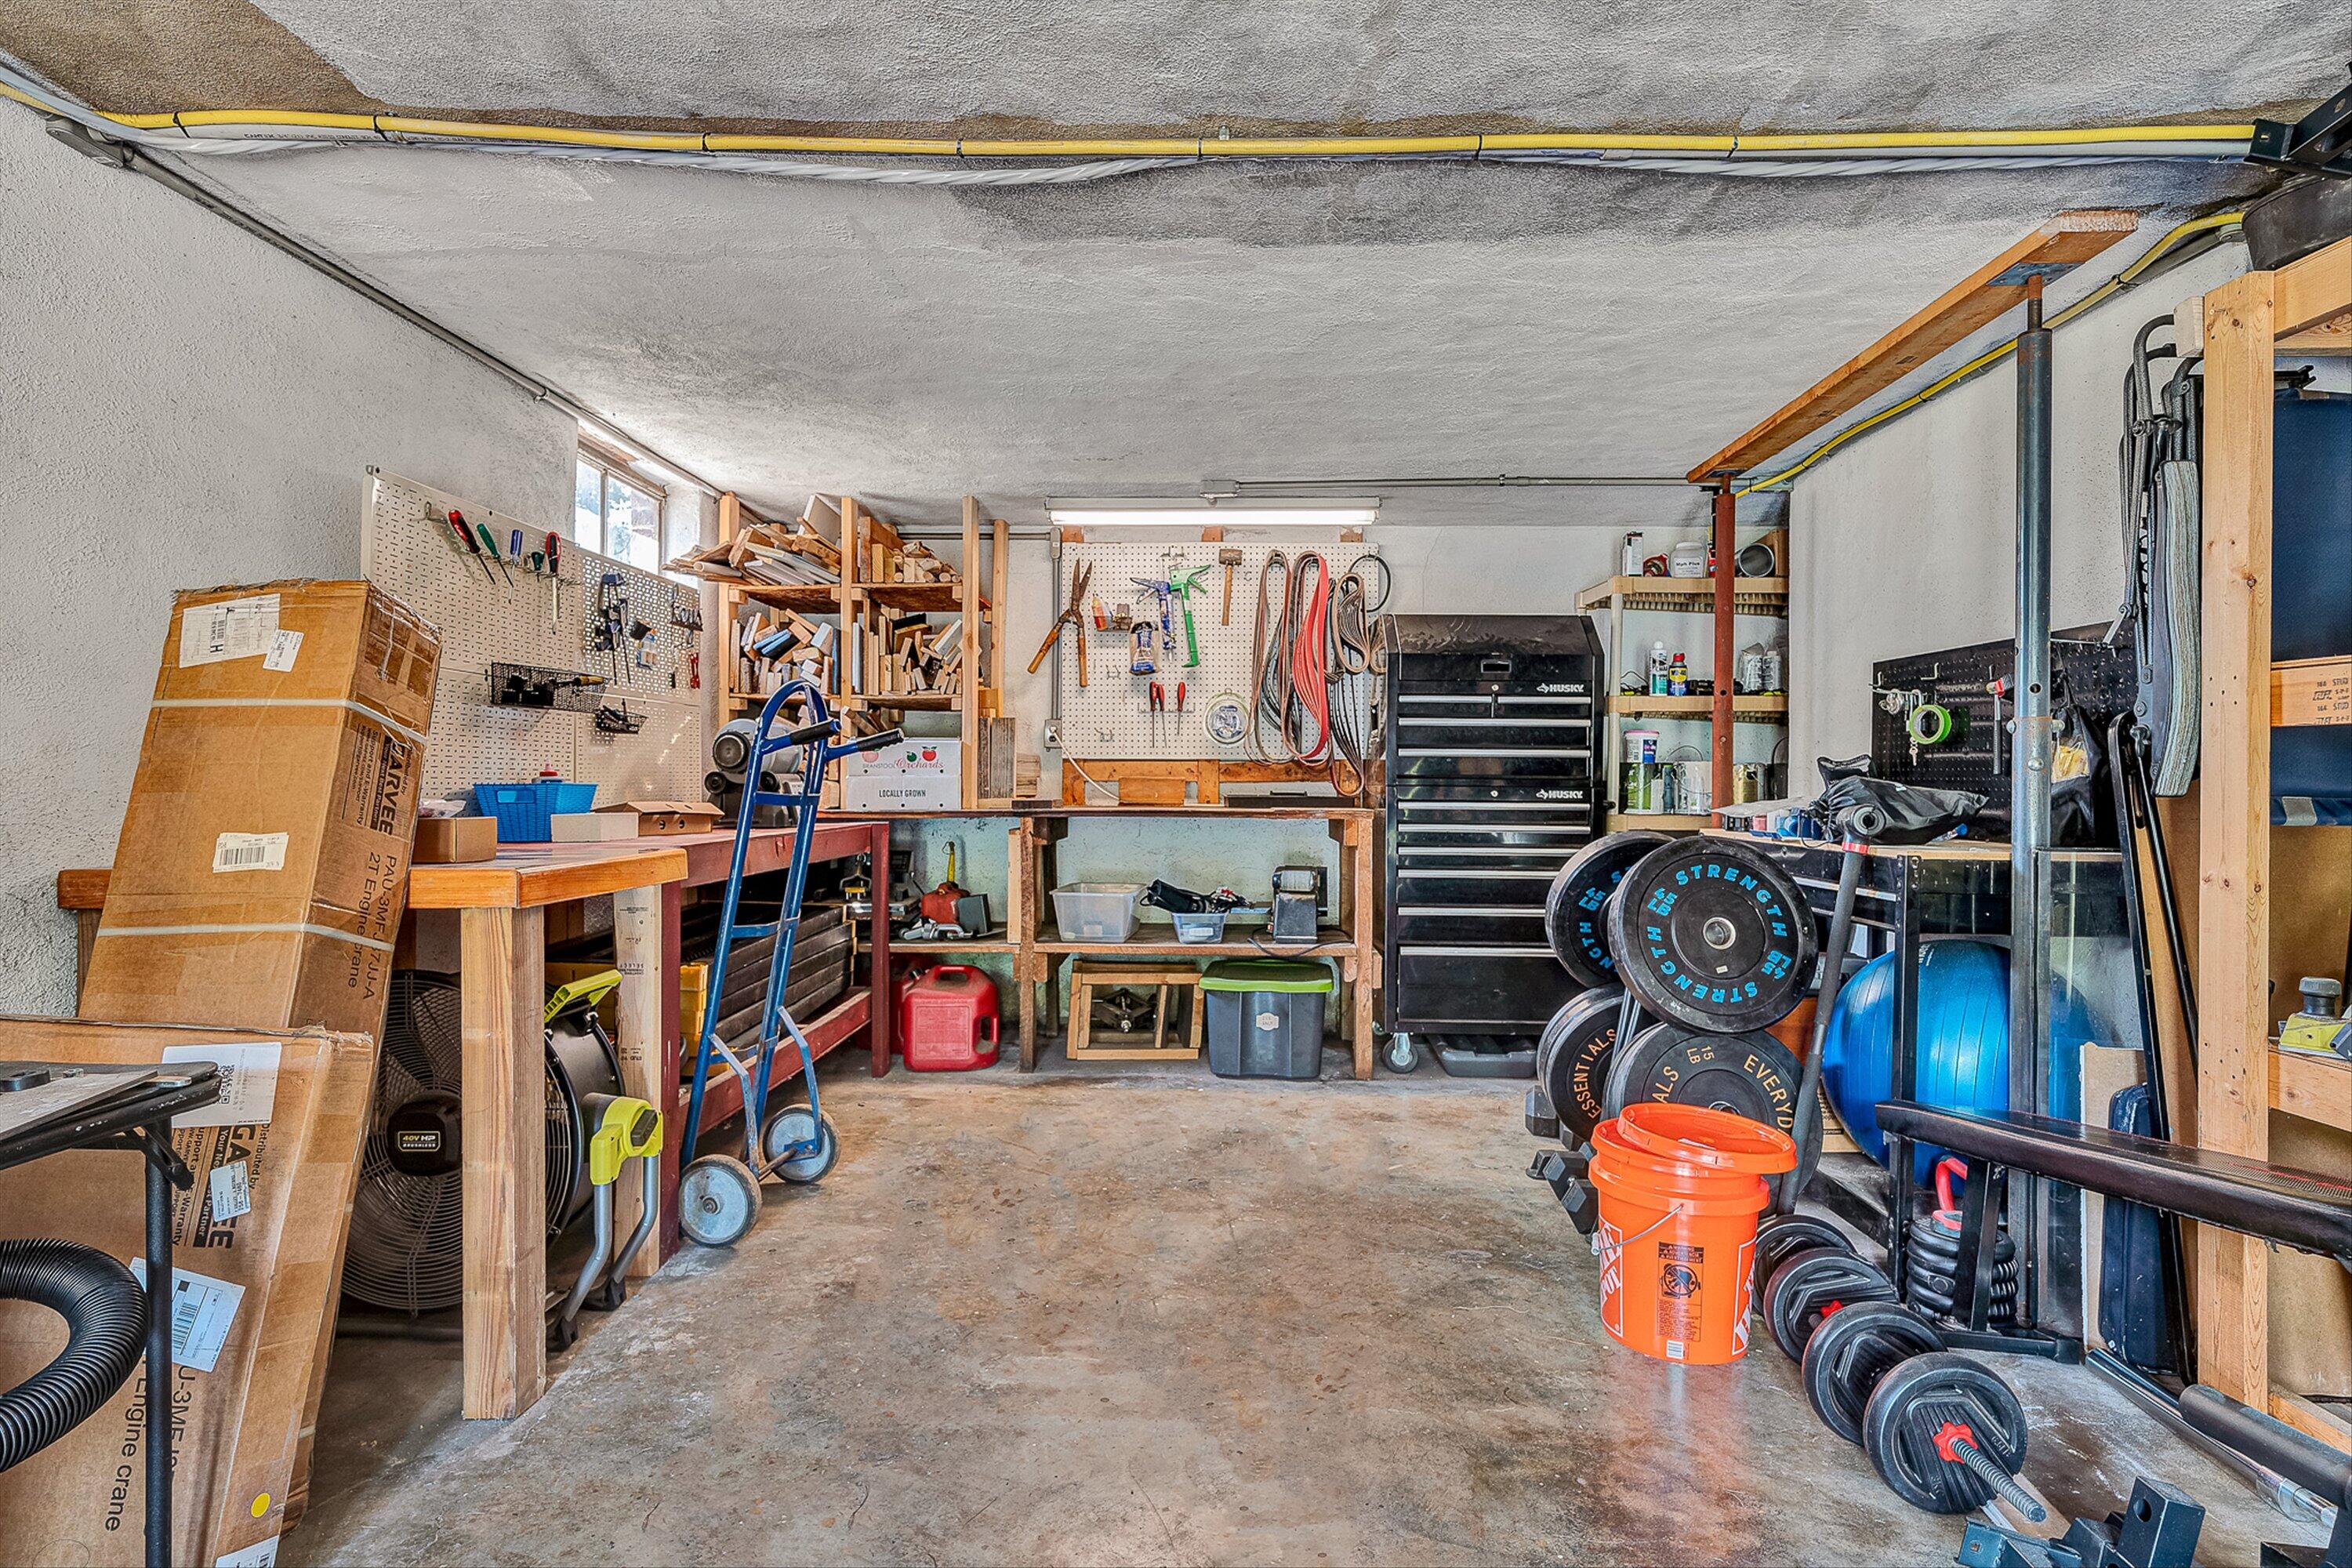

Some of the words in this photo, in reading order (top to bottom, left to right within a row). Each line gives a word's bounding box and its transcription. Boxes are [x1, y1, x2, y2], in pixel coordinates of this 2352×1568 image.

[1549, 684, 1584, 692] HUSKY
[368, 730, 379, 763] Support
[895, 757, 945, 769] Orchards
[878, 789, 903, 798] LOCALLY
[904, 789, 927, 798] GROWN
[1548, 790, 1584, 799] HUSKY
[373, 794, 383, 822] Partner
[368, 851, 381, 875] 2T
[1578, 896, 1600, 911] LB
[1585, 887, 1606, 901] 45
[1654, 887, 1678, 904] 45
[1675, 864, 1788, 937] STRENGTH
[357, 878, 376, 936] Engine
[1647, 898, 1671, 916] LB
[1646, 926, 1758, 1004] STRENGTH
[1767, 949, 1792, 969] LB
[1761, 962, 1785, 980] 45
[1686, 1047, 1701, 1065] LB
[1700, 1045, 1715, 1061] 15
[1573, 1028, 1617, 1120] ESSENTIALS
[191, 1126, 205, 1162] upport
[216, 1128, 230, 1152] Your
[248, 1174, 261, 1189] by
[197, 1199, 212, 1237] Partner
[104, 1465, 132, 1532] crane
